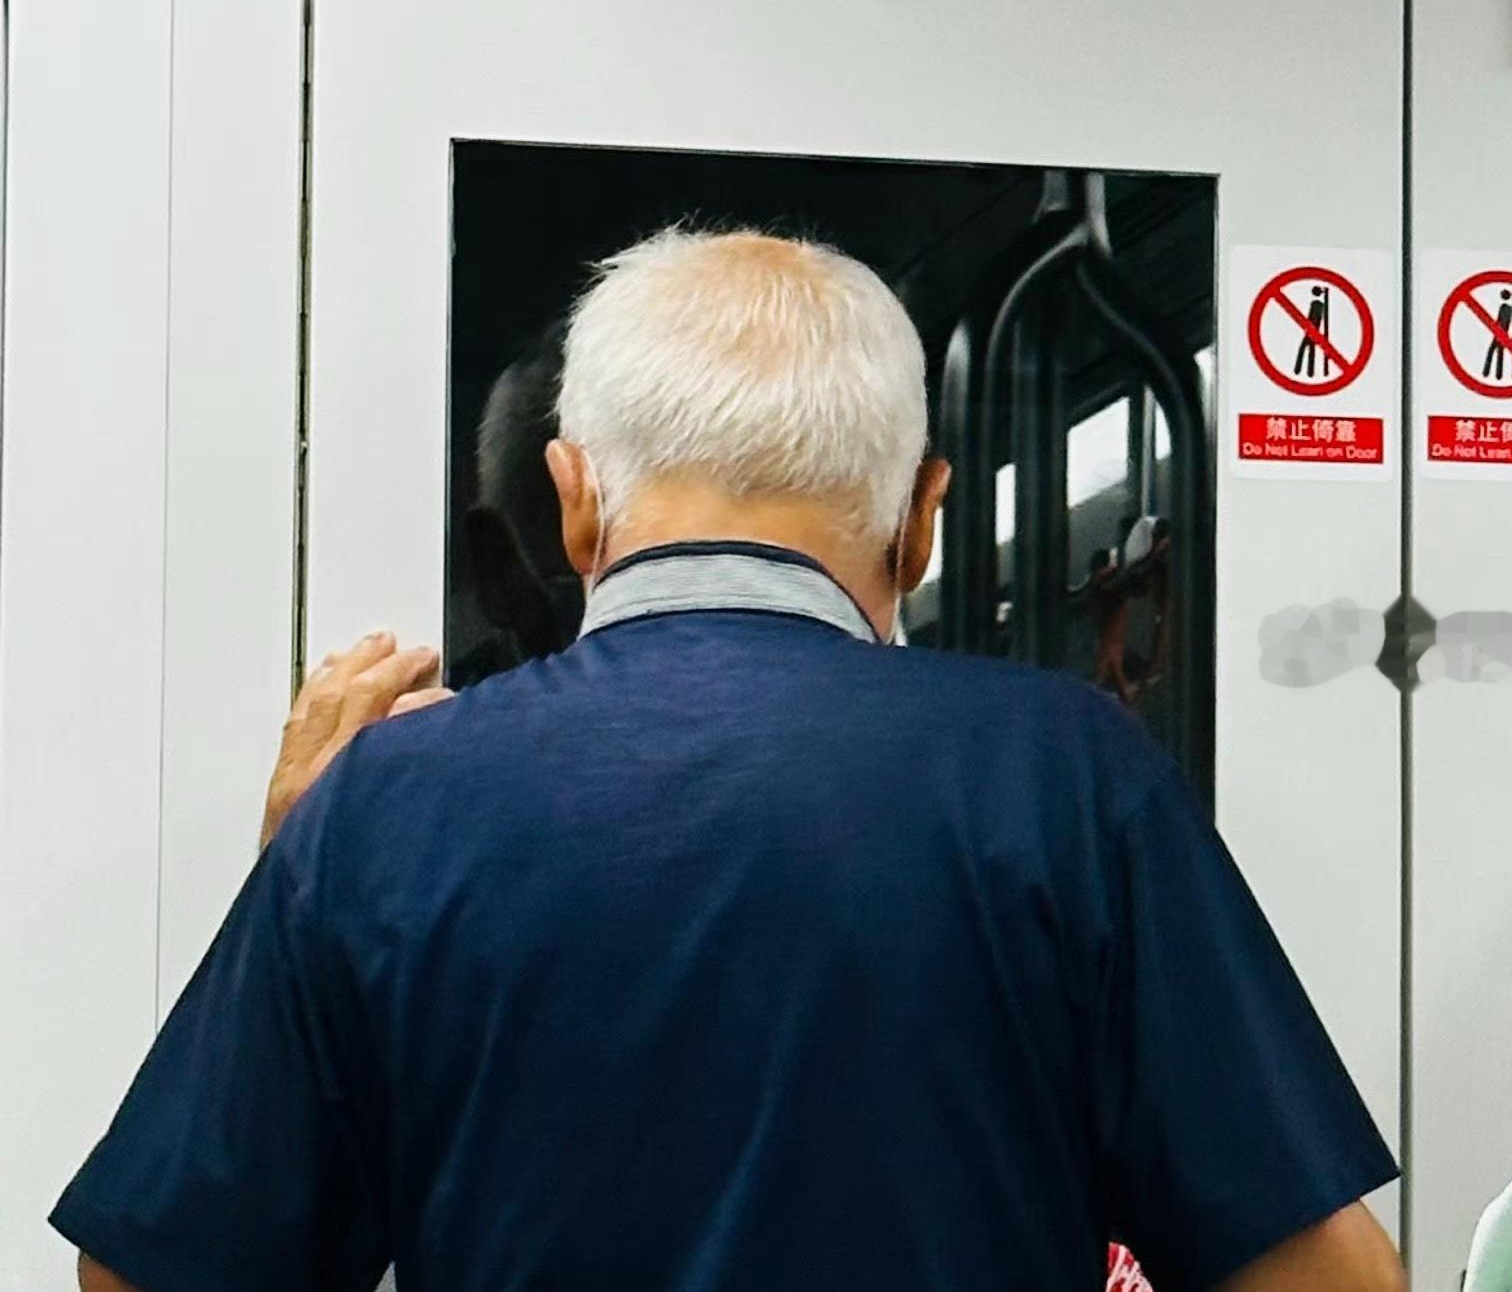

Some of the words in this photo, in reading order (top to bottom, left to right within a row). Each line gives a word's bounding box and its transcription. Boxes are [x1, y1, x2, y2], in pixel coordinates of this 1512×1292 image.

[1266, 417, 1357, 443] 禁止倚靠
[1242, 442, 1262, 456] Do
[1265, 443, 1288, 456] Not
[1291, 444, 1323, 458] Lean
[1326, 447, 1343, 458] on
[1345, 445, 1377, 459] Door
[1431, 443, 1452, 457] Do
[1454, 445, 1477, 458] Not
